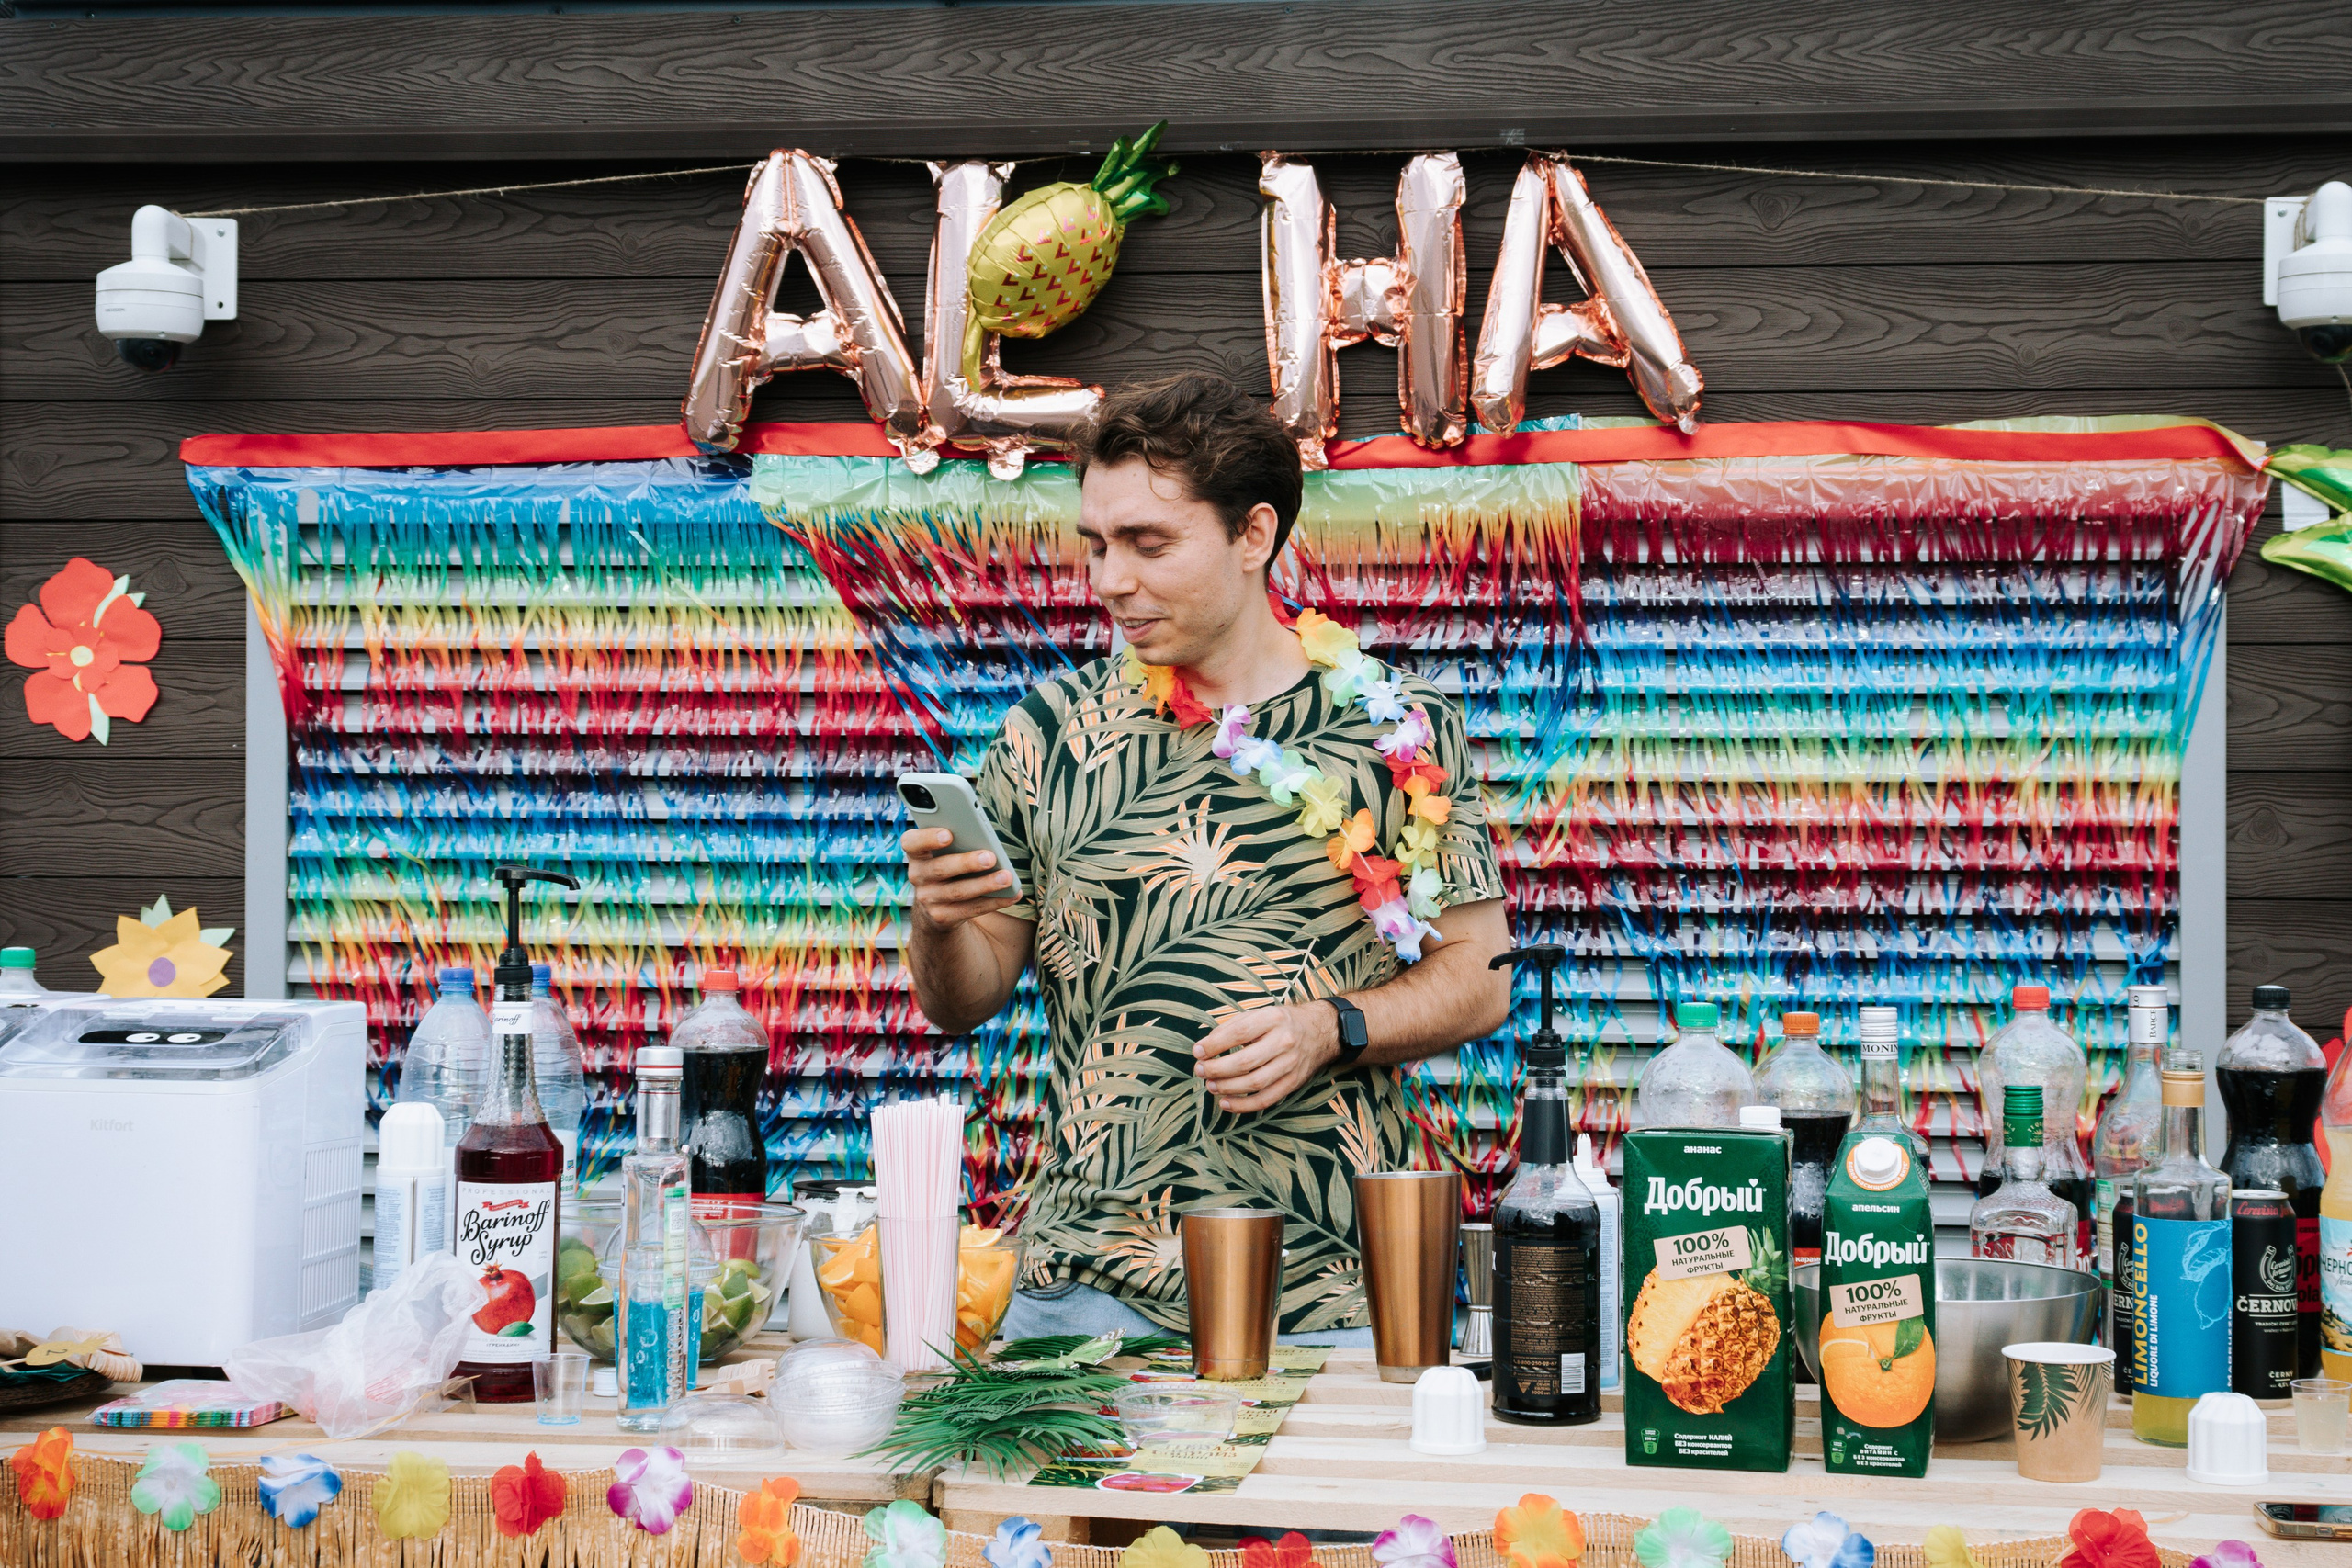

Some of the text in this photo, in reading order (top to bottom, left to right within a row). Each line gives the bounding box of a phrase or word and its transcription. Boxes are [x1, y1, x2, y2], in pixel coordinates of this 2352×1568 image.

[90, 1118, 134, 1131] Kitfort
[1683, 1145, 1722, 1154] ананас
[462, 1187, 551, 1195] PROFESSIONAL
[1644, 1177, 1763, 1216] Добрый
[1852, 1204, 1900, 1213] апельсин
[460, 1199, 551, 1242] Barinoff
[470, 1231, 533, 1266] Syrup
[1673, 1232, 1729, 1250] 100%
[1825, 1231, 1928, 1269] Добрый
[1671, 1250, 1735, 1270] НАТУРАЛЬНЫЕ
[1686, 1262, 1724, 1278] ФРУКТЫ
[1846, 1280, 1902, 1303] 100%
[1844, 1298, 1909, 1314] НАТУРАЛЬНЫЕ
[2134, 1223, 2148, 1386] LIMONCELLO
[1860, 1311, 1897, 1323] ФРУКТЫ
[2149, 1294, 2160, 1388] LIQUORE DI LIMONE
[1708, 1433, 1733, 1441] КАЛИЙ
